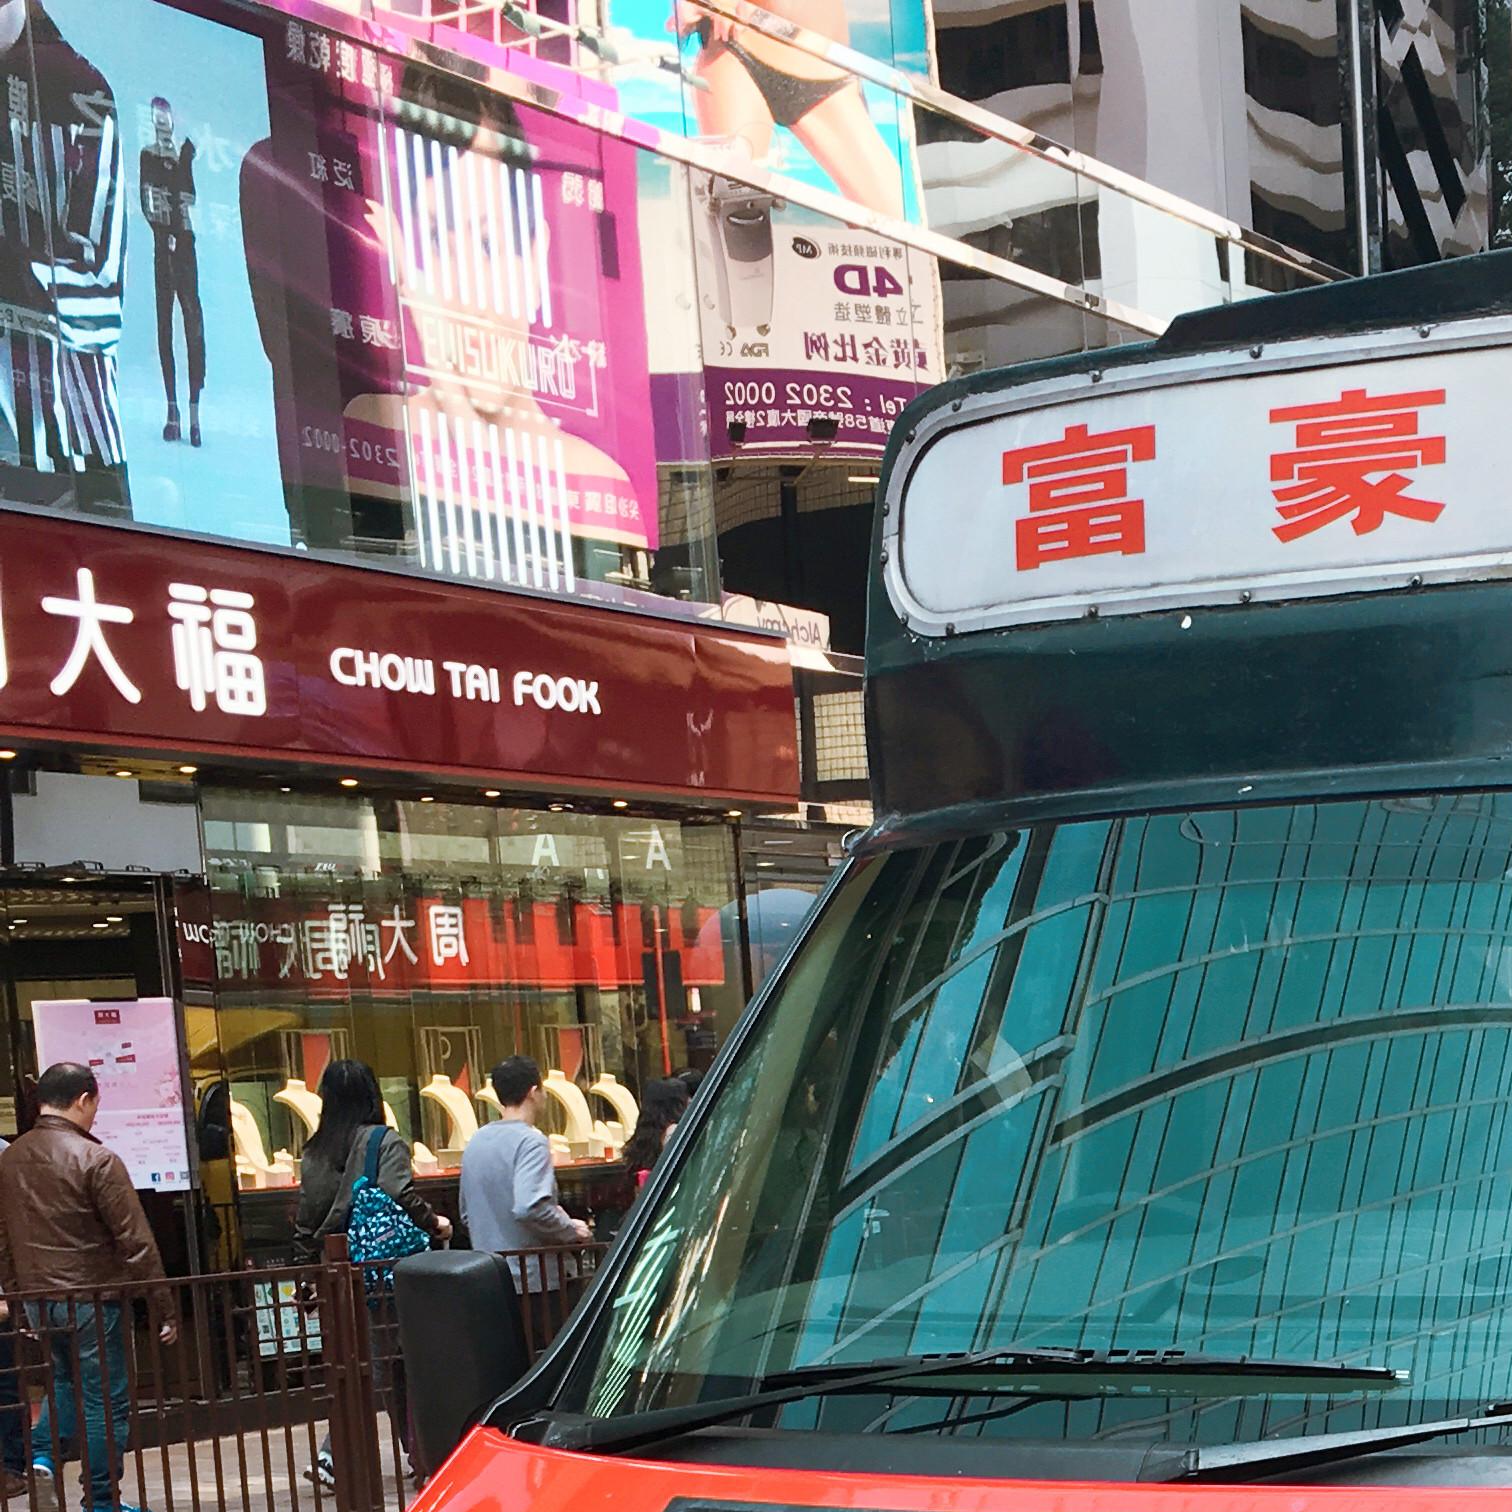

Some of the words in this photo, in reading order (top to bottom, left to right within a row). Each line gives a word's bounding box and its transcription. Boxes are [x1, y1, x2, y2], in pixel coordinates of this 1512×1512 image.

[0, 566, 268, 717] 大福
[329, 646, 434, 696] CHOW
[442, 660, 501, 703] TAI
[512, 670, 602, 715] FOOK
